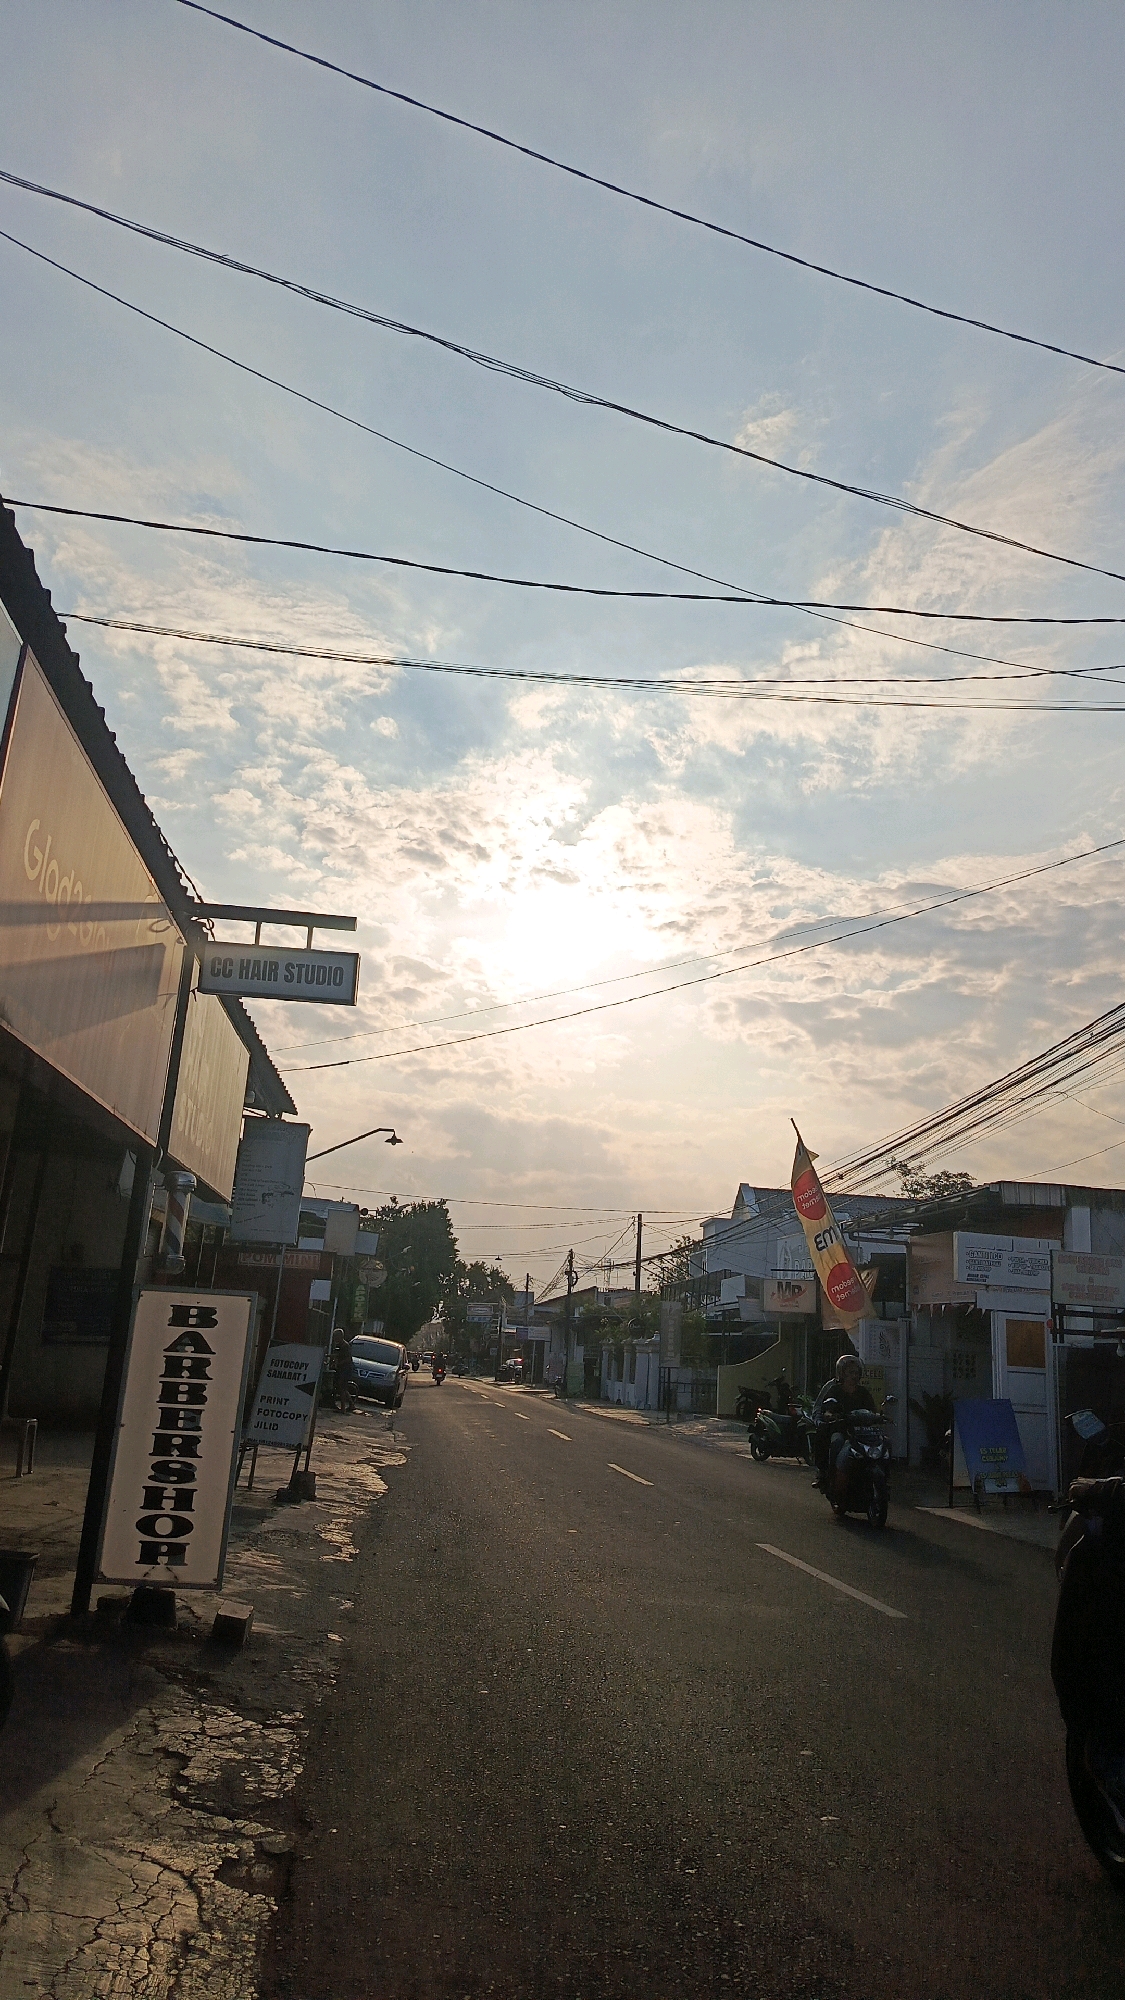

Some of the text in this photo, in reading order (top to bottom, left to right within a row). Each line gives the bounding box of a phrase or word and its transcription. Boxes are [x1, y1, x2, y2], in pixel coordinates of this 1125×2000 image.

[210, 956, 345, 987] CC HAIR STUDIO
[353, 1284, 366, 1319] APOTEK
[270, 1359, 310, 1371] FOTOCOPY
[260, 1395, 290, 1406] PRINT
[257, 1408, 309, 1421] FOTOCOPY
[253, 1421, 279, 1431] JILID
[135, 1304, 219, 1567] BARBERSHOP
